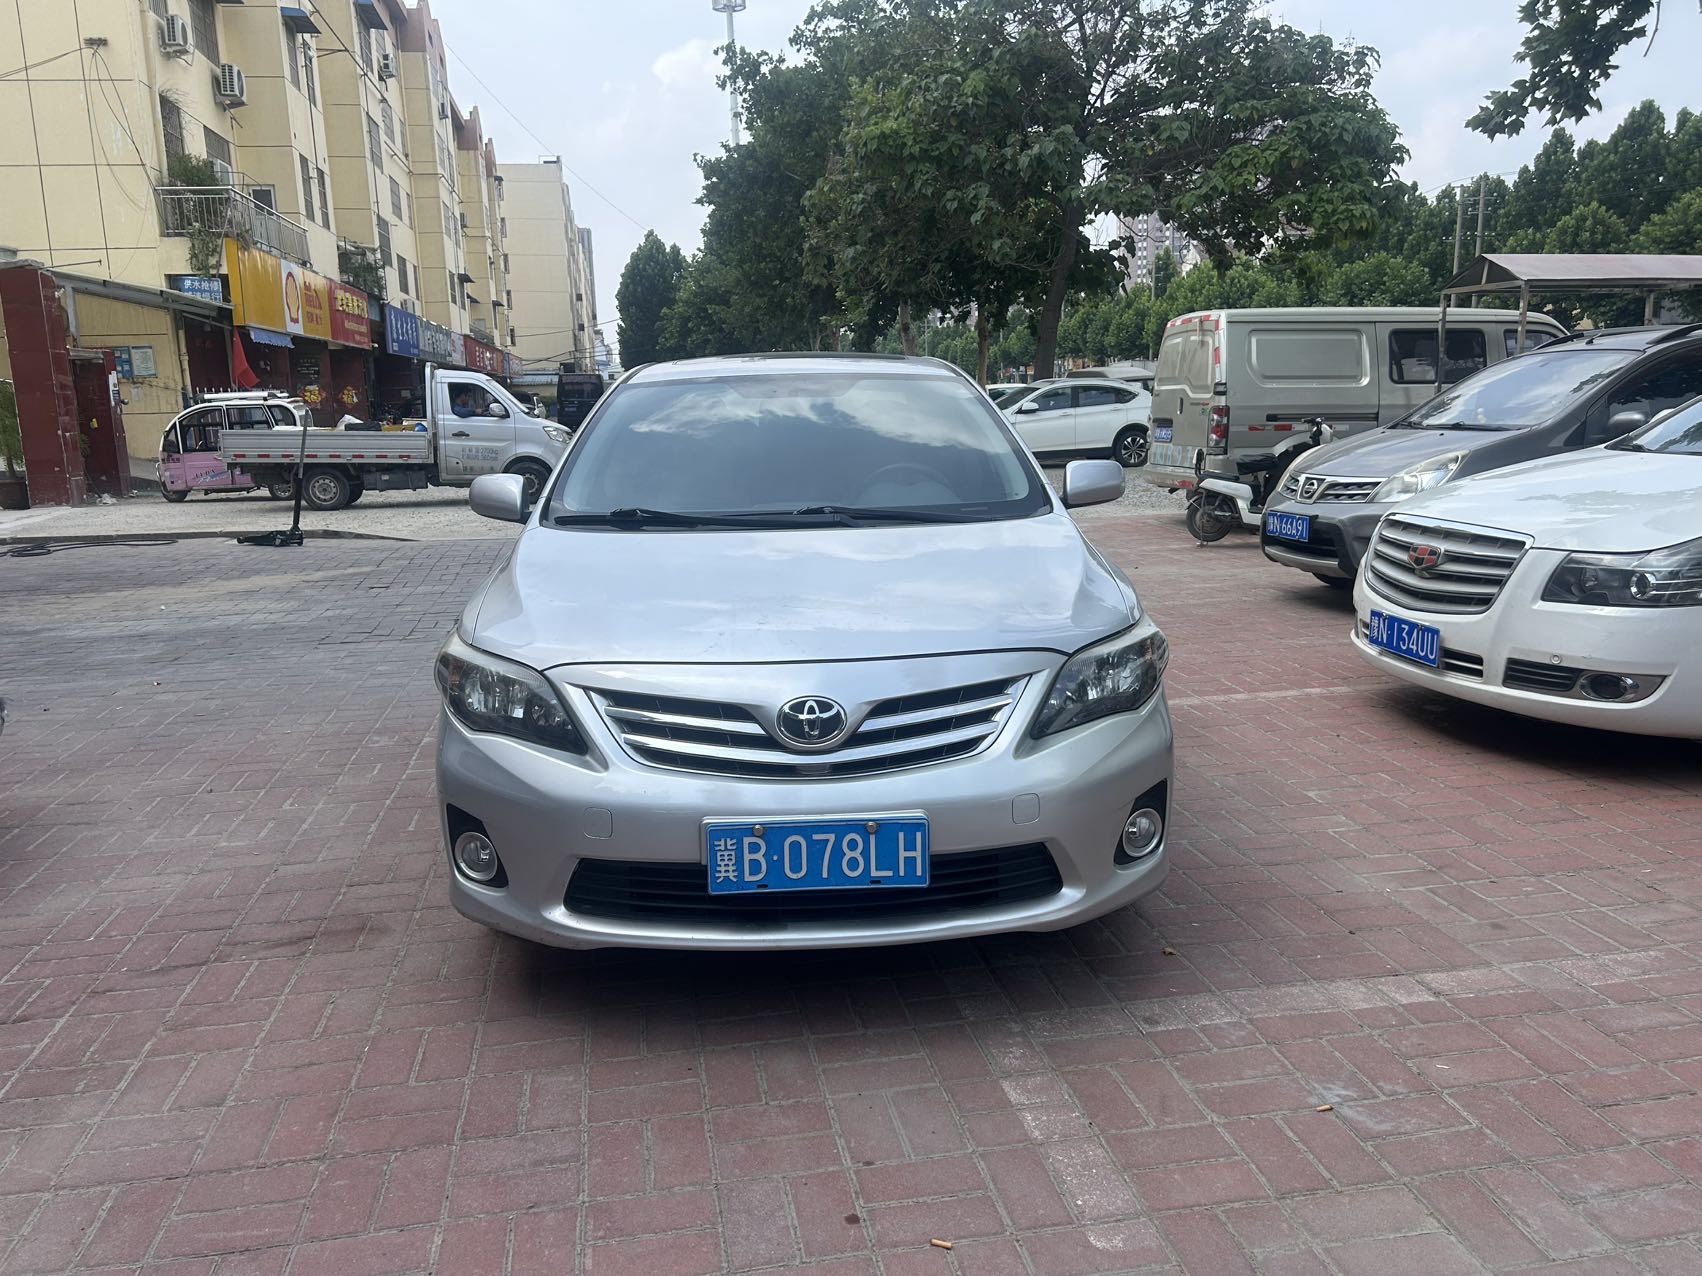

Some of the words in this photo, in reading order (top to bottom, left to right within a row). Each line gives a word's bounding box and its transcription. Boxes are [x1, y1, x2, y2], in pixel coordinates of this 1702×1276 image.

[184, 280, 220, 291] 供水抢修
[714, 831, 922, 883] 冀B·078LH
